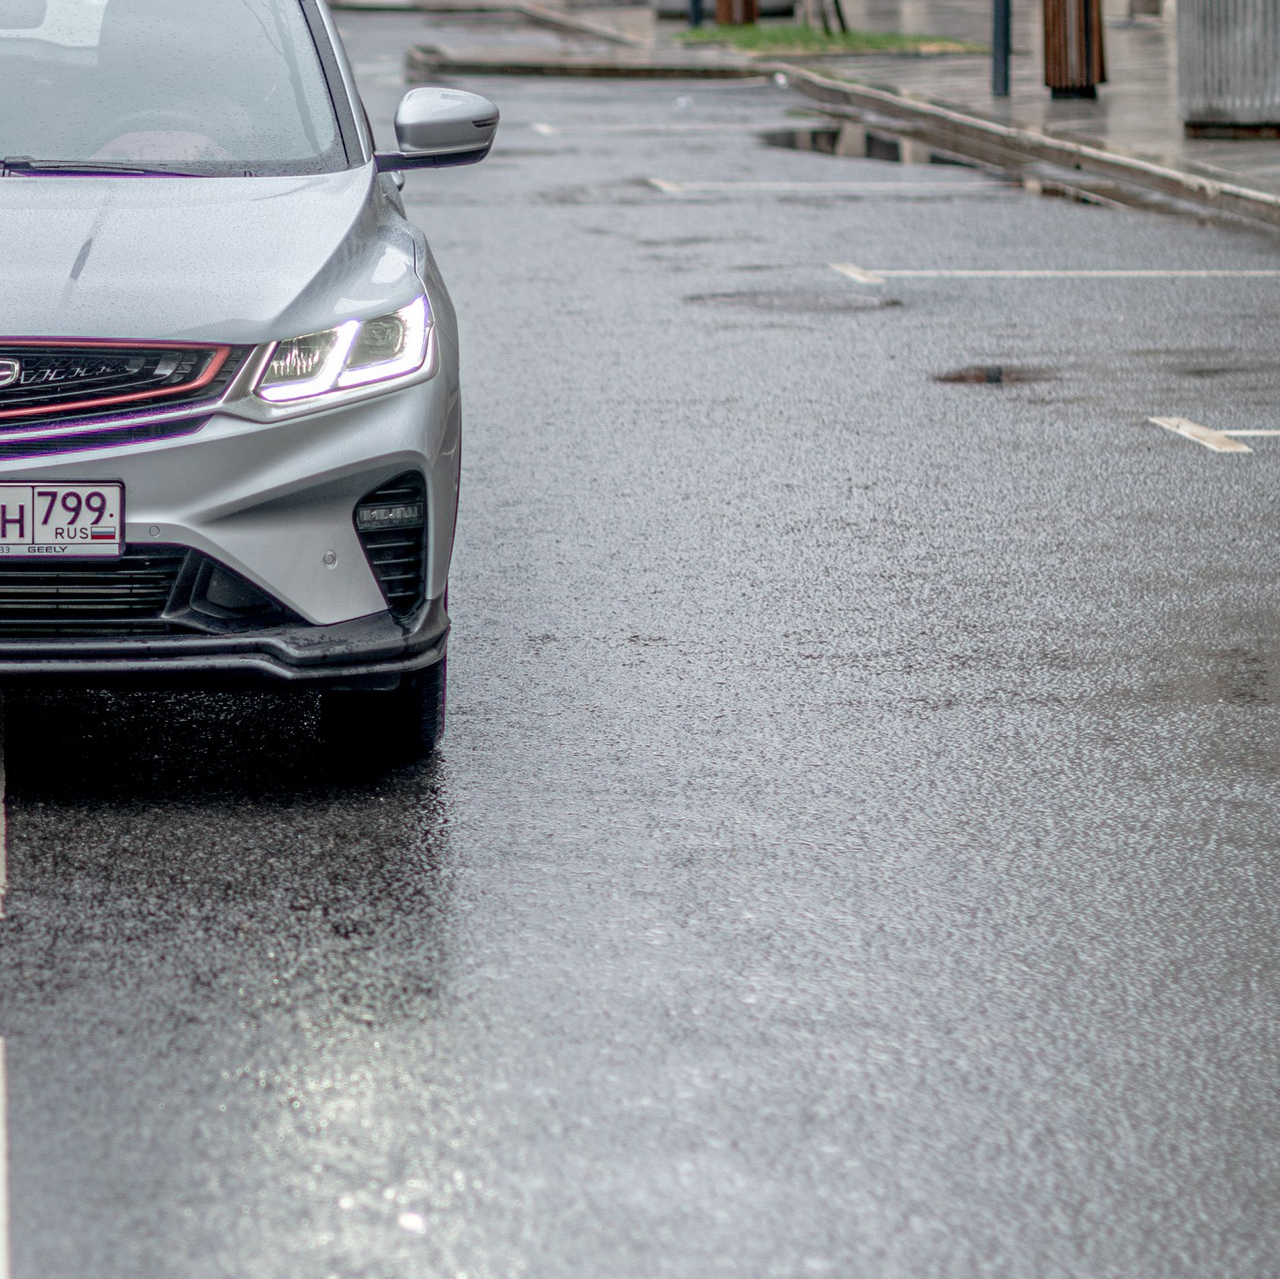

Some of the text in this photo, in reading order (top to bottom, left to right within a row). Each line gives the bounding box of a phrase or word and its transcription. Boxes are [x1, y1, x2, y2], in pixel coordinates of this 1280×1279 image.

[36, 491, 107, 526] 799
[54, 526, 89, 540] RUS
[0, 545, 11, 554] 33
[27, 545, 68, 554] GEELY
